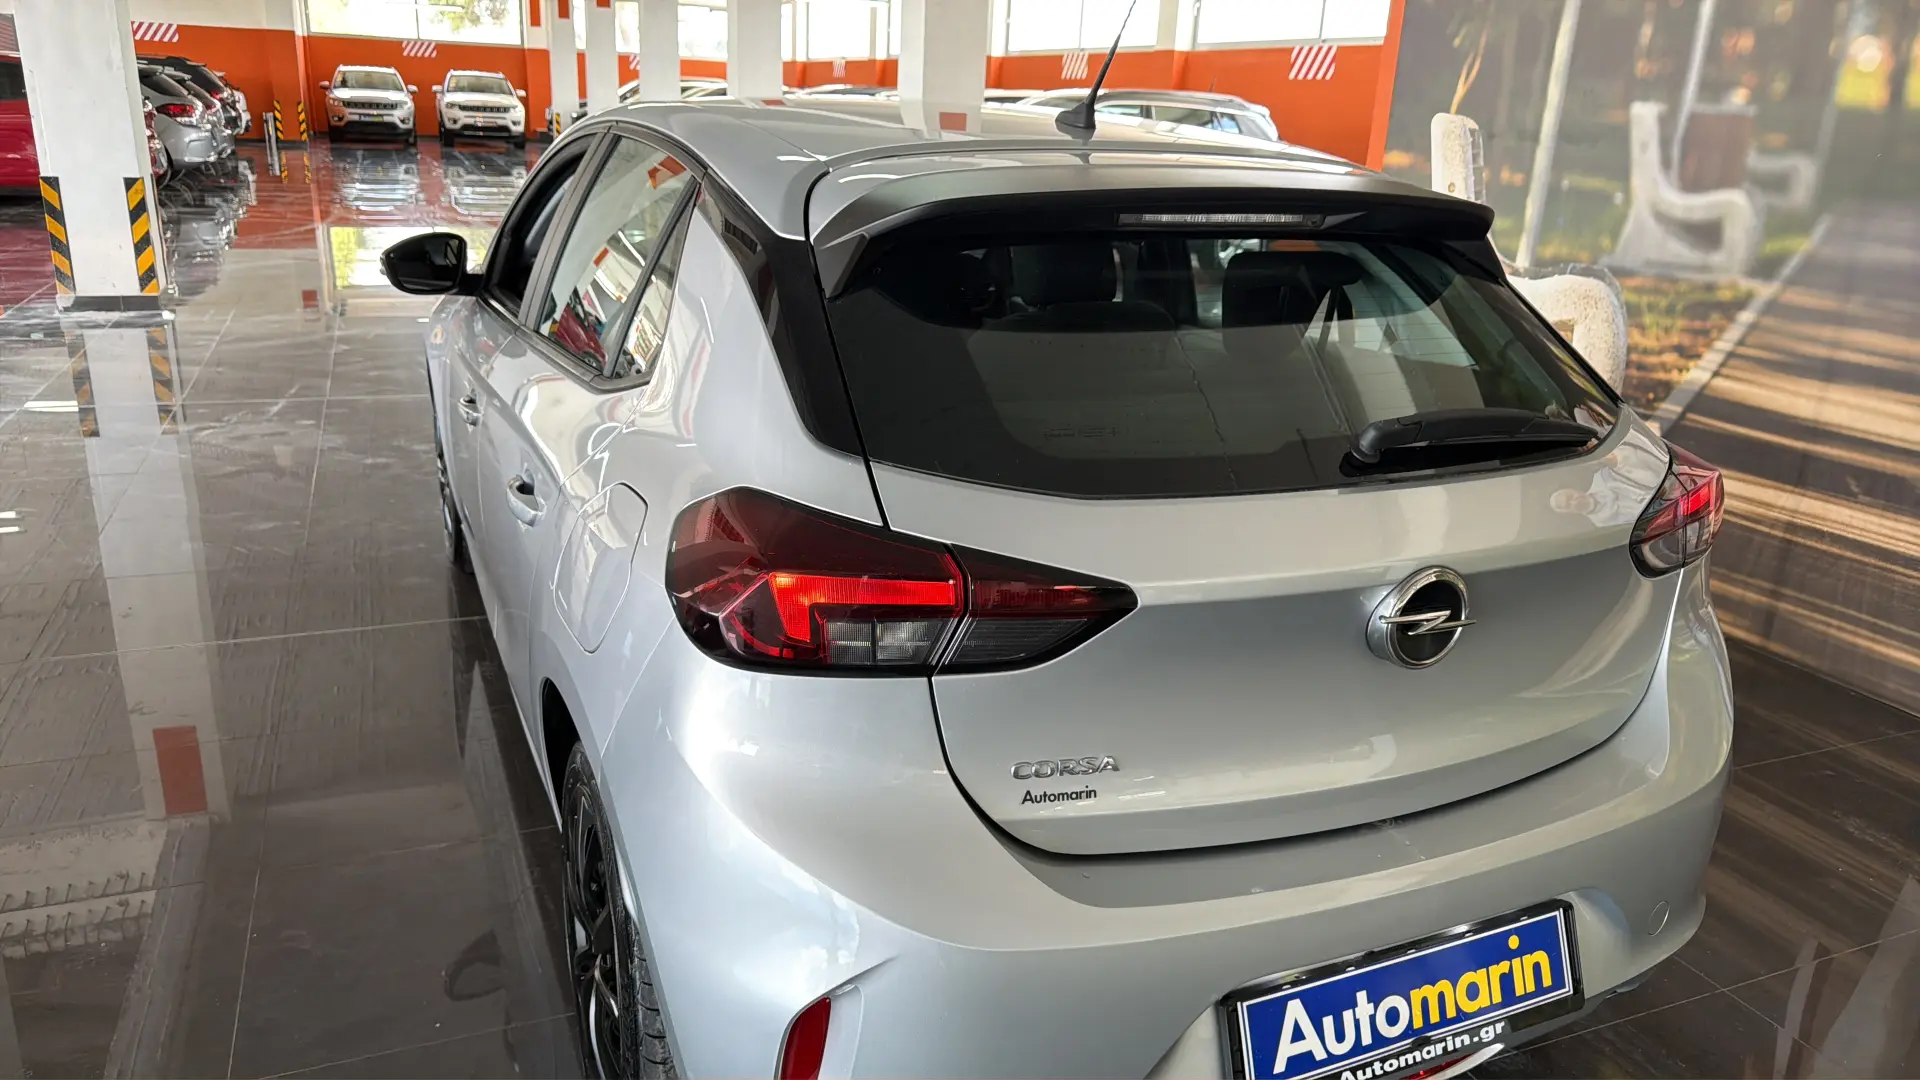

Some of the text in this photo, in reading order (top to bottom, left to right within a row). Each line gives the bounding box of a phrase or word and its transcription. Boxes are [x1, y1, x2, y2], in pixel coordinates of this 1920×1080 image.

[1010, 755, 1120, 780] CORSA
[1021, 785, 1097, 805] Automarin
[1273, 935, 1552, 1075] Automarin
